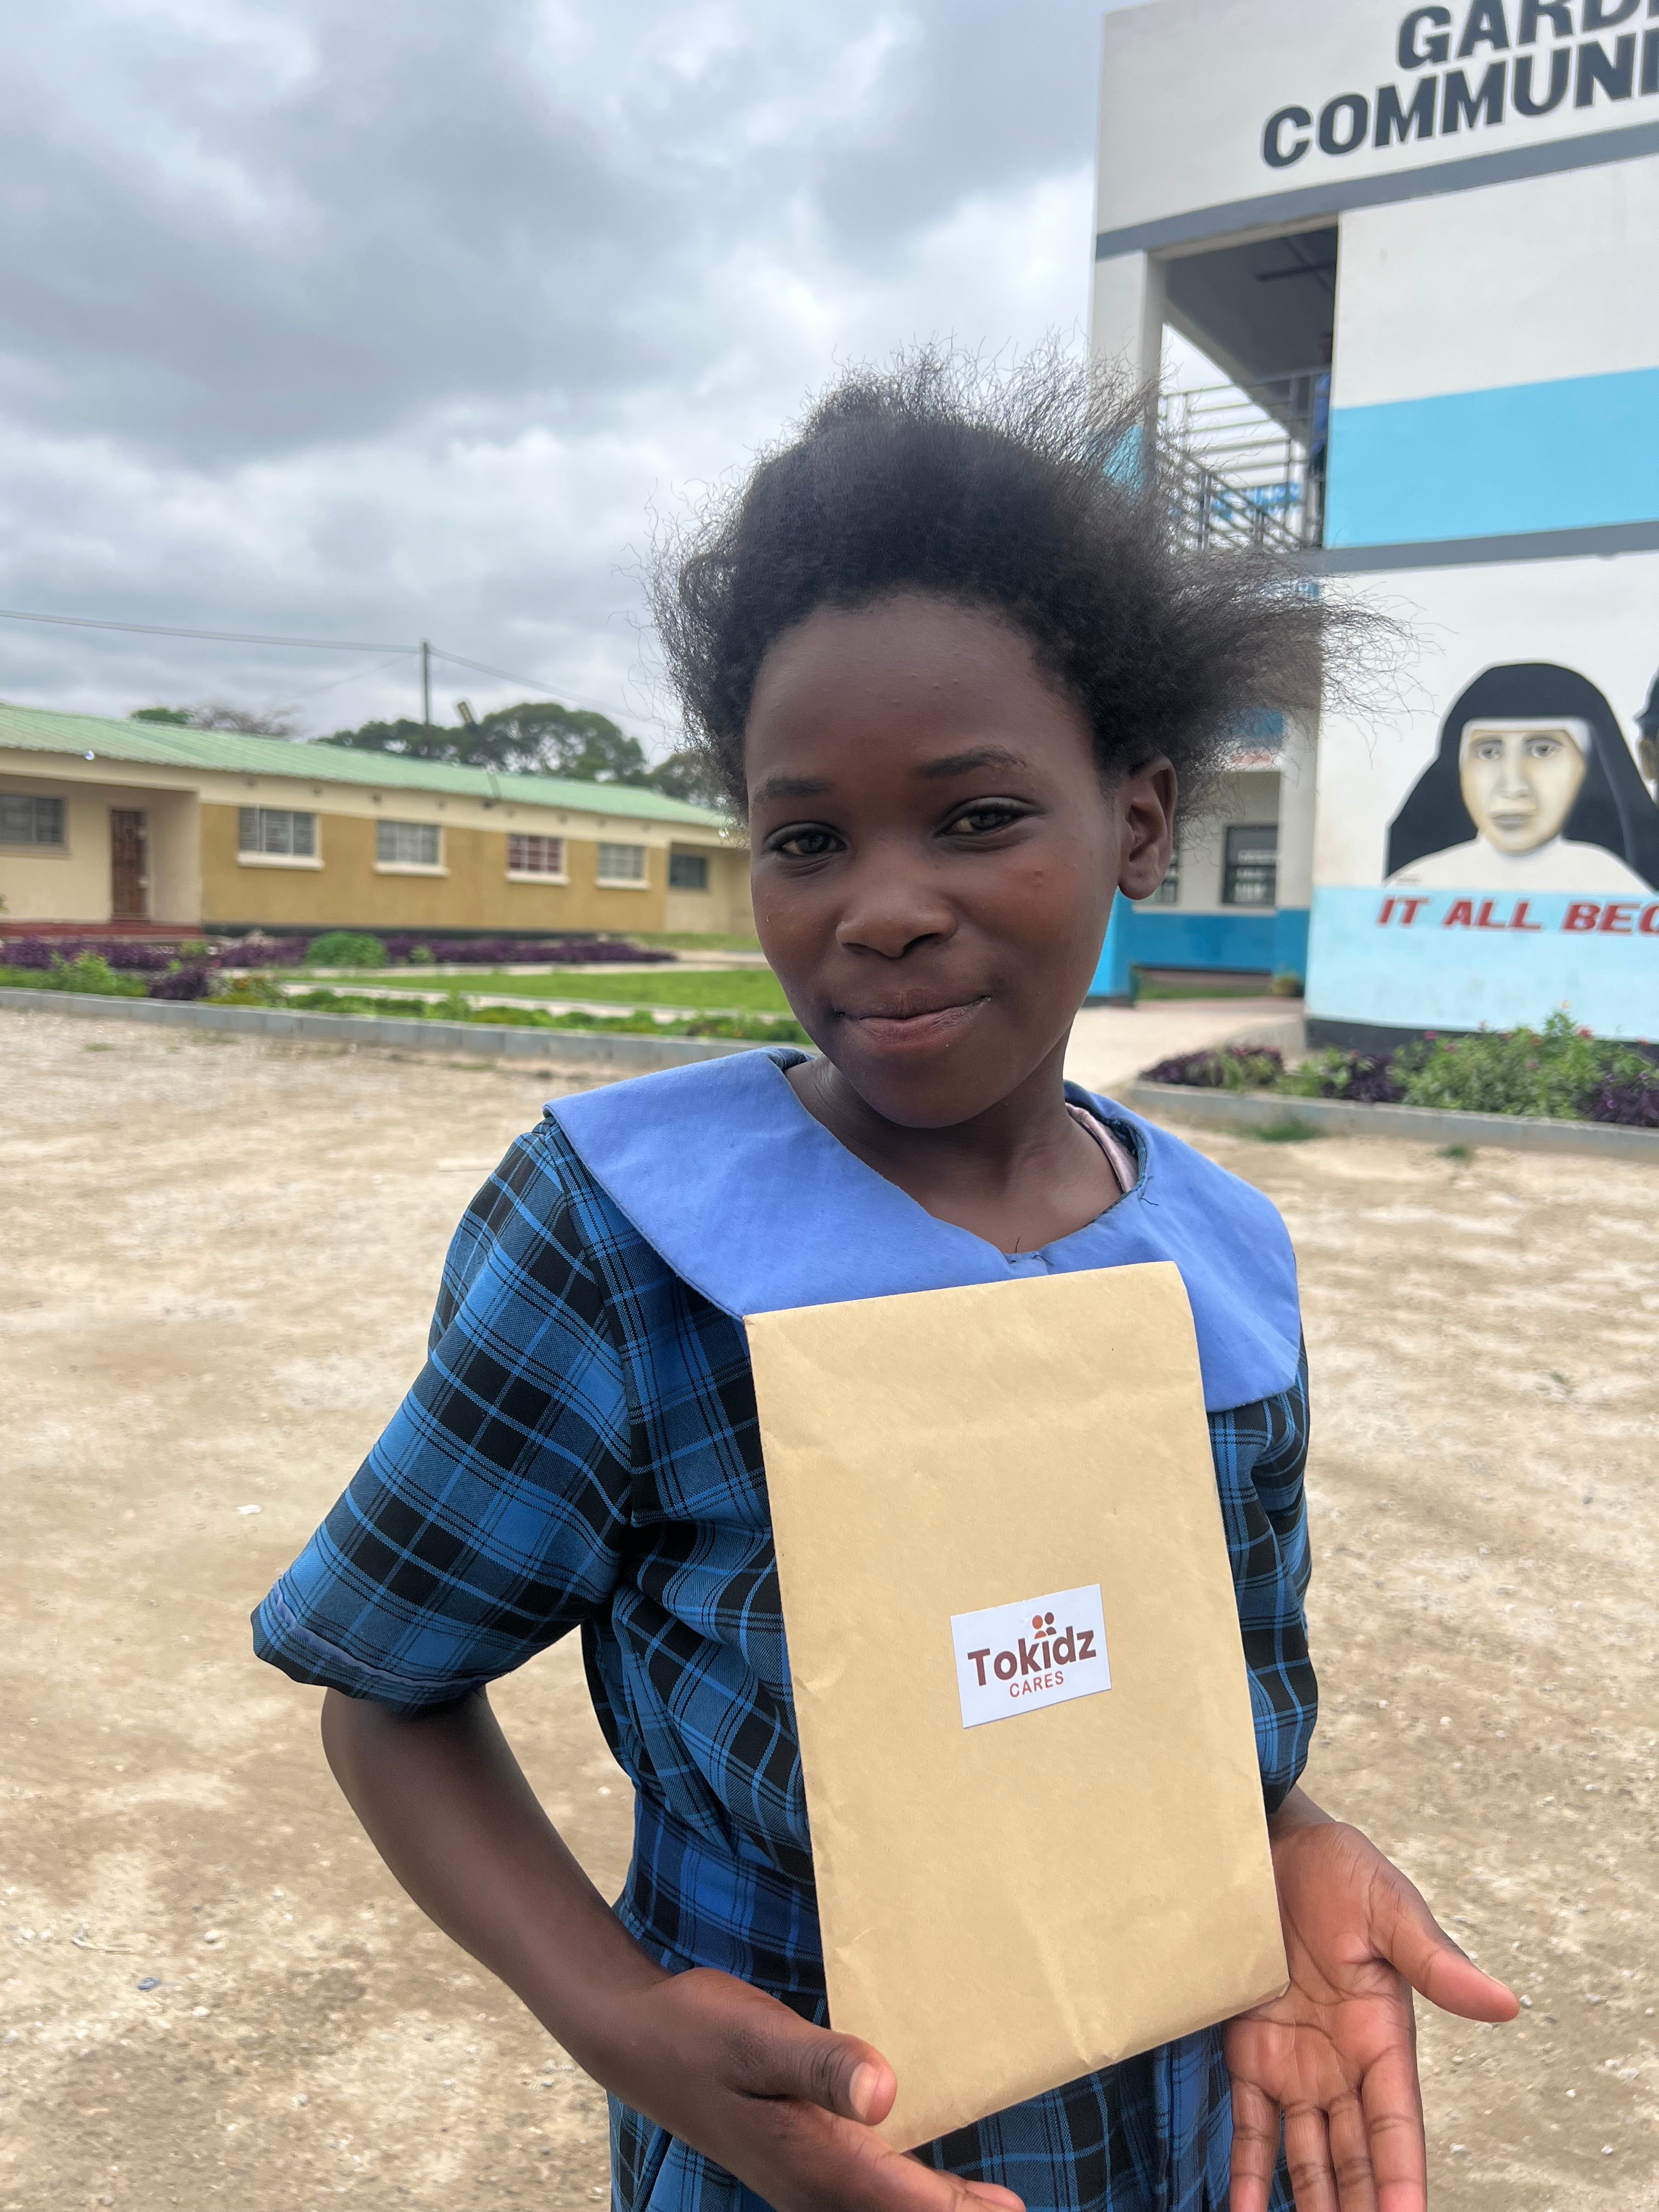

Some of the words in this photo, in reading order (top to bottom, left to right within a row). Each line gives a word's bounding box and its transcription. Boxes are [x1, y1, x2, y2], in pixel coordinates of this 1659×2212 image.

[1397, 0, 1659, 69] GARD
[1263, 29, 1659, 167] COMMUNI
[1377, 895, 1430, 927] IT
[1442, 898, 1543, 932] ALL
[967, 1626, 1096, 1686] Tokidz
[1009, 1671, 1064, 1697] CARES
